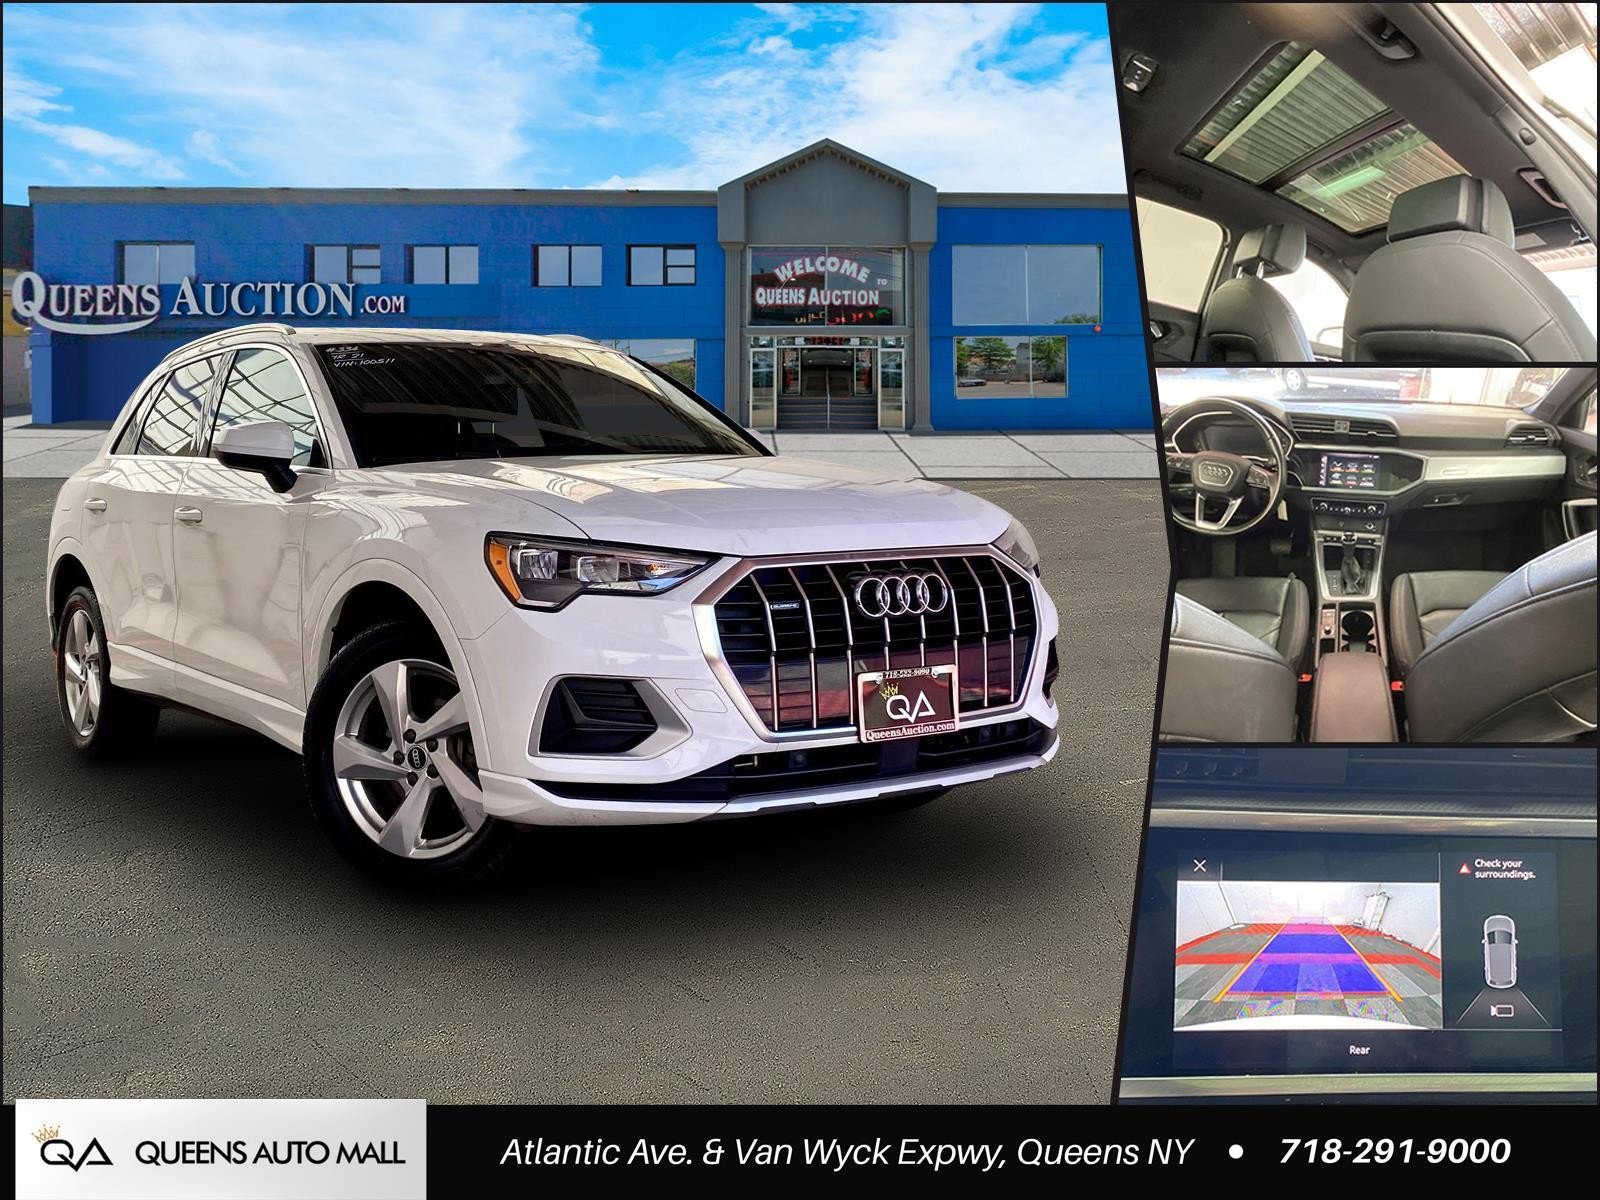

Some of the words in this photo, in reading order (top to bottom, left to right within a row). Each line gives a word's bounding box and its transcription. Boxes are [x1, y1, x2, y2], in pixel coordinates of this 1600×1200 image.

[774, 256, 870, 283] WELCOME
[11, 271, 162, 334] QUEENS
[755, 287, 805, 305] QUEENS
[807, 287, 879, 305] AUCTION
[866, 722, 955, 740] QueensAuction.com
[1474, 858, 1499, 869] Check
[1501, 860, 1523, 871] your
[1474, 868, 1536, 880] surroundings.
[1349, 1045, 1371, 1055] Rear
